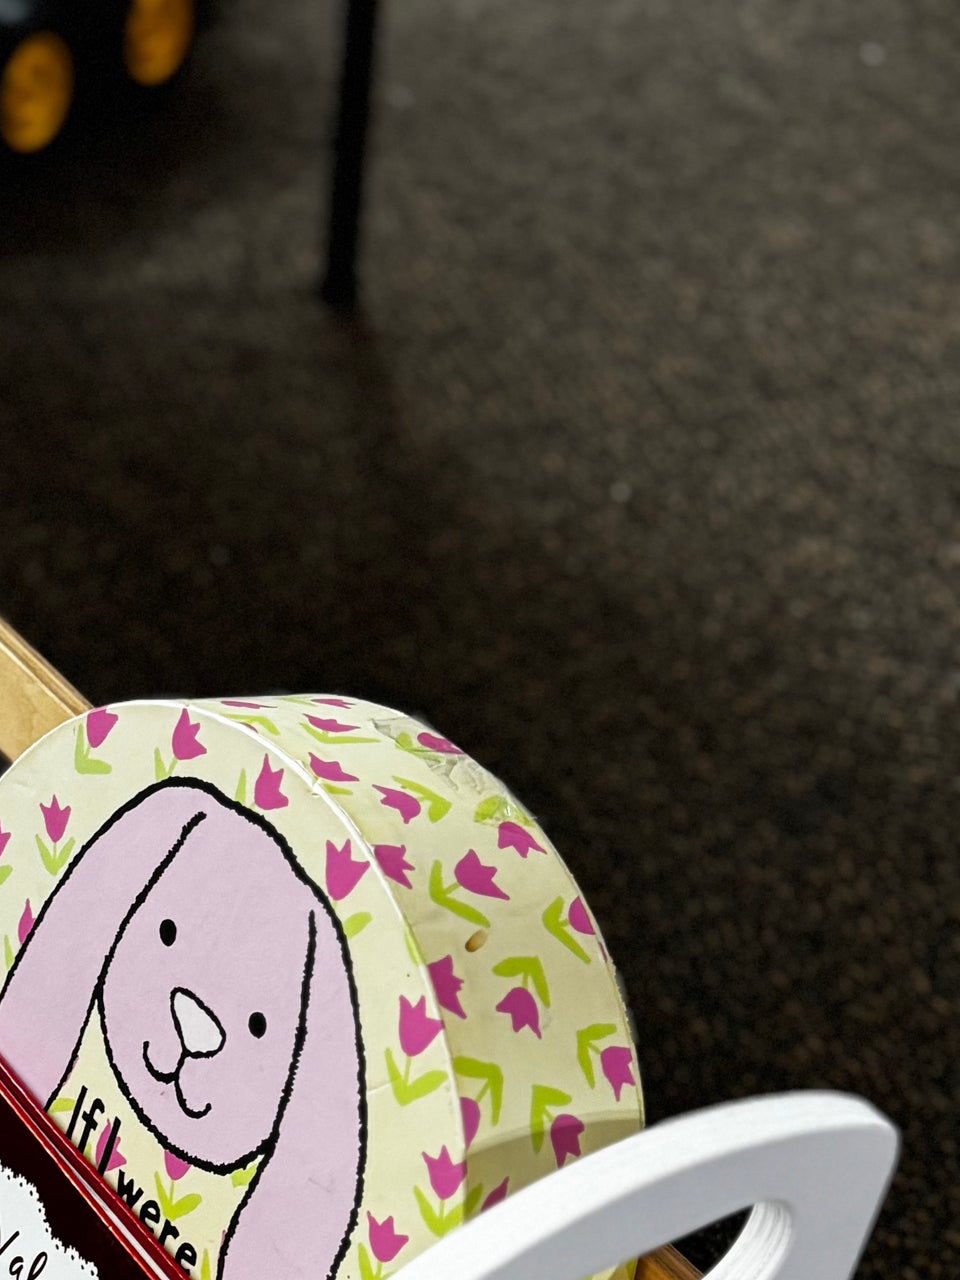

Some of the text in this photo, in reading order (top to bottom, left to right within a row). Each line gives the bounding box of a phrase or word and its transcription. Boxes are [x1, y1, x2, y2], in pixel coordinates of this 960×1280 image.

[66, 1085, 197, 1276] If I were
